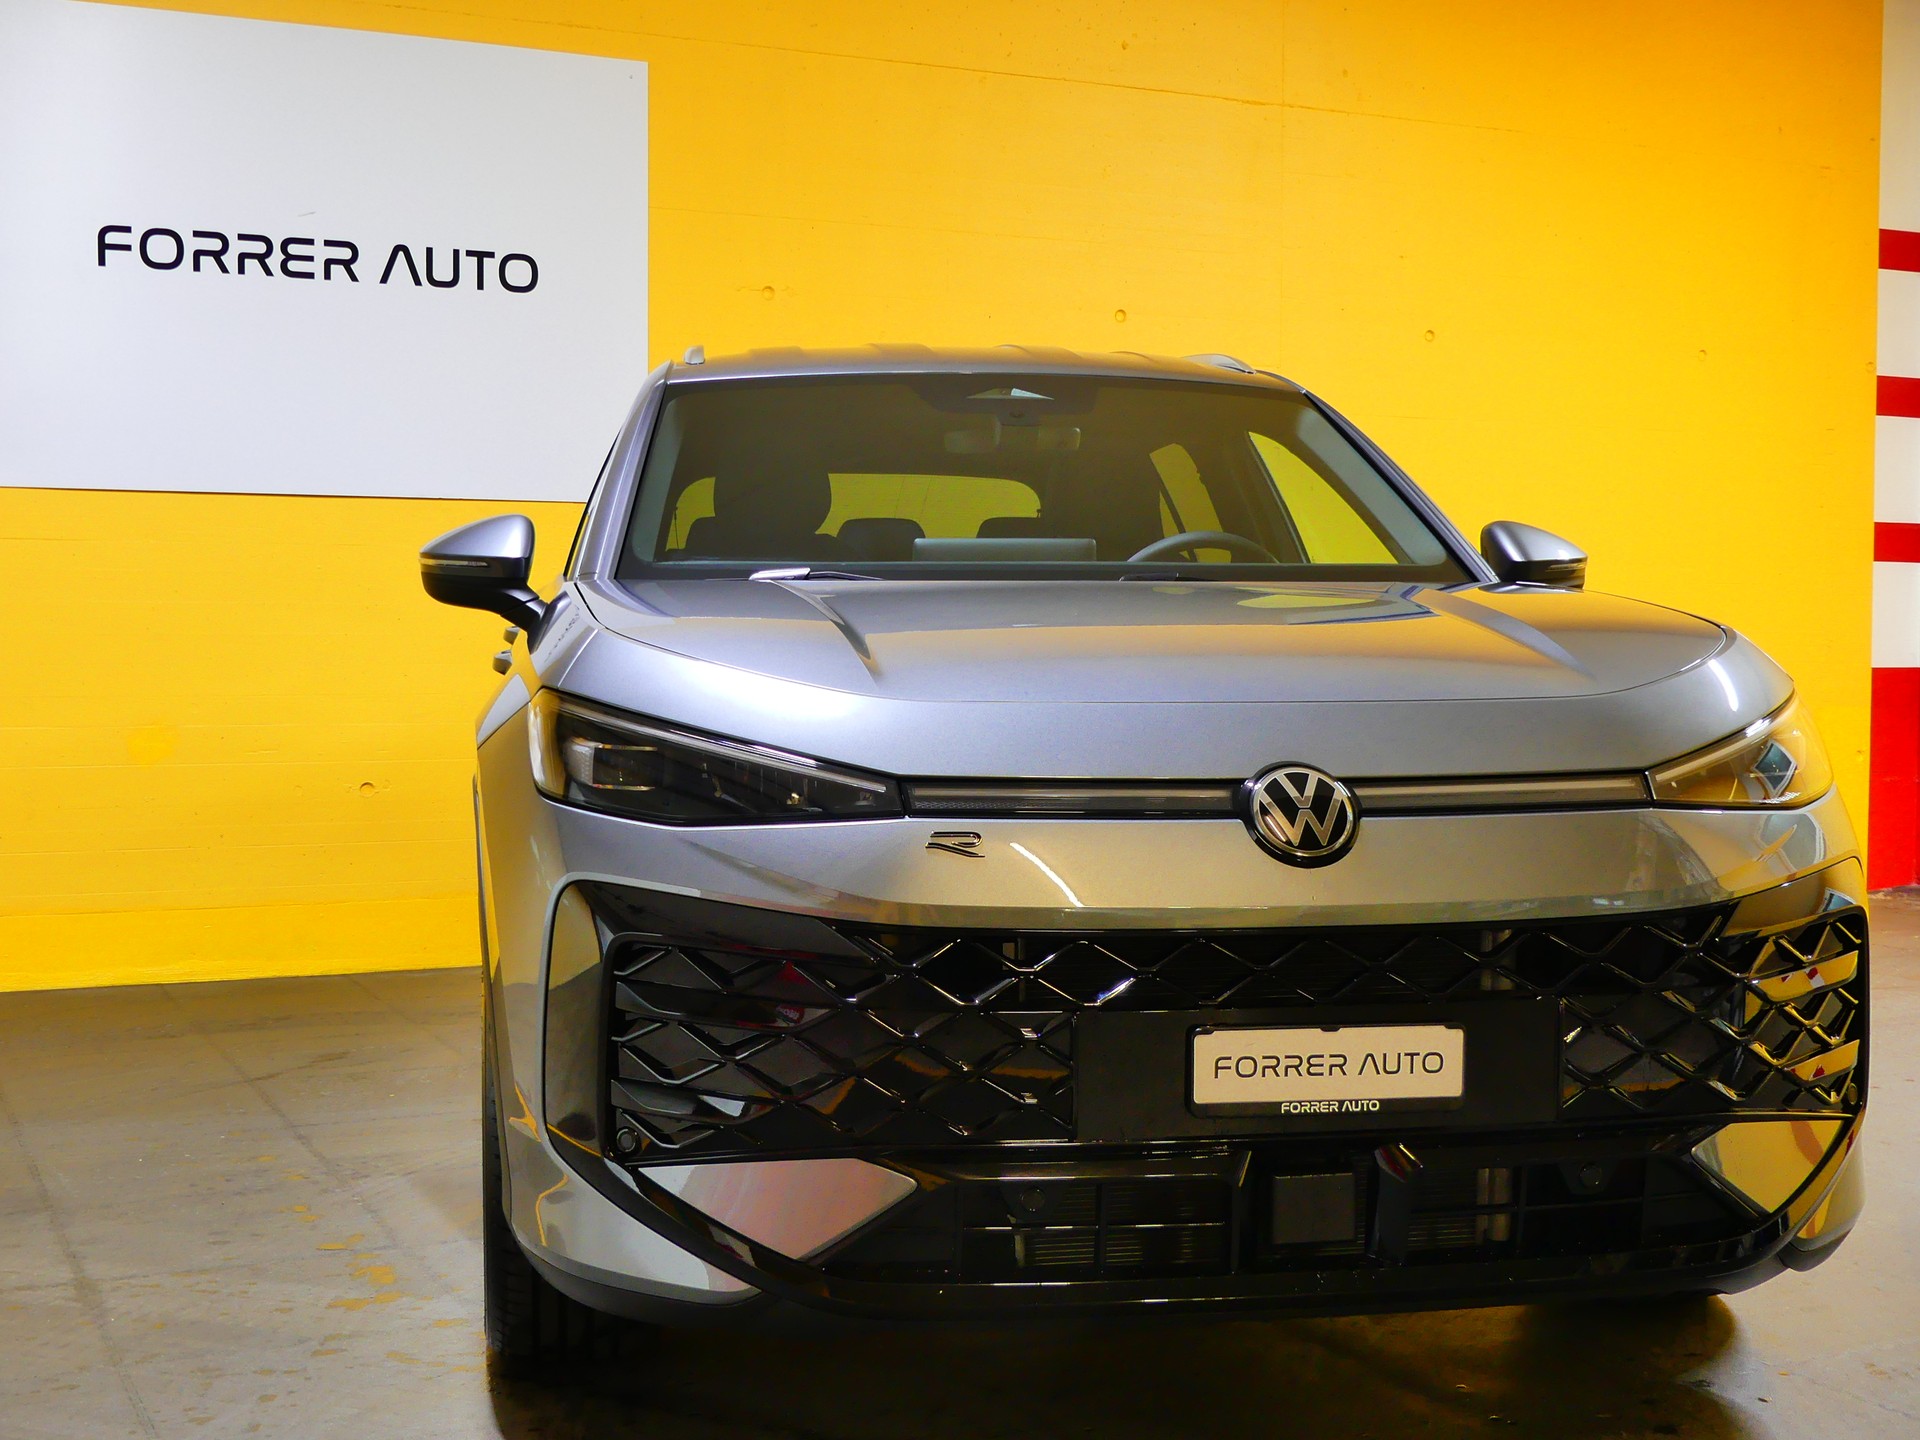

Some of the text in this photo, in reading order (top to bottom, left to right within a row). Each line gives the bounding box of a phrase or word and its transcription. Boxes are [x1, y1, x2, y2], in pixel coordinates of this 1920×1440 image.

[97, 225, 539, 293] FORRER AUTO
[1256, 769, 1352, 853] VW
[1213, 1051, 1445, 1079] FORRER AUTO
[1281, 1100, 1380, 1114] FORRER AUTO
